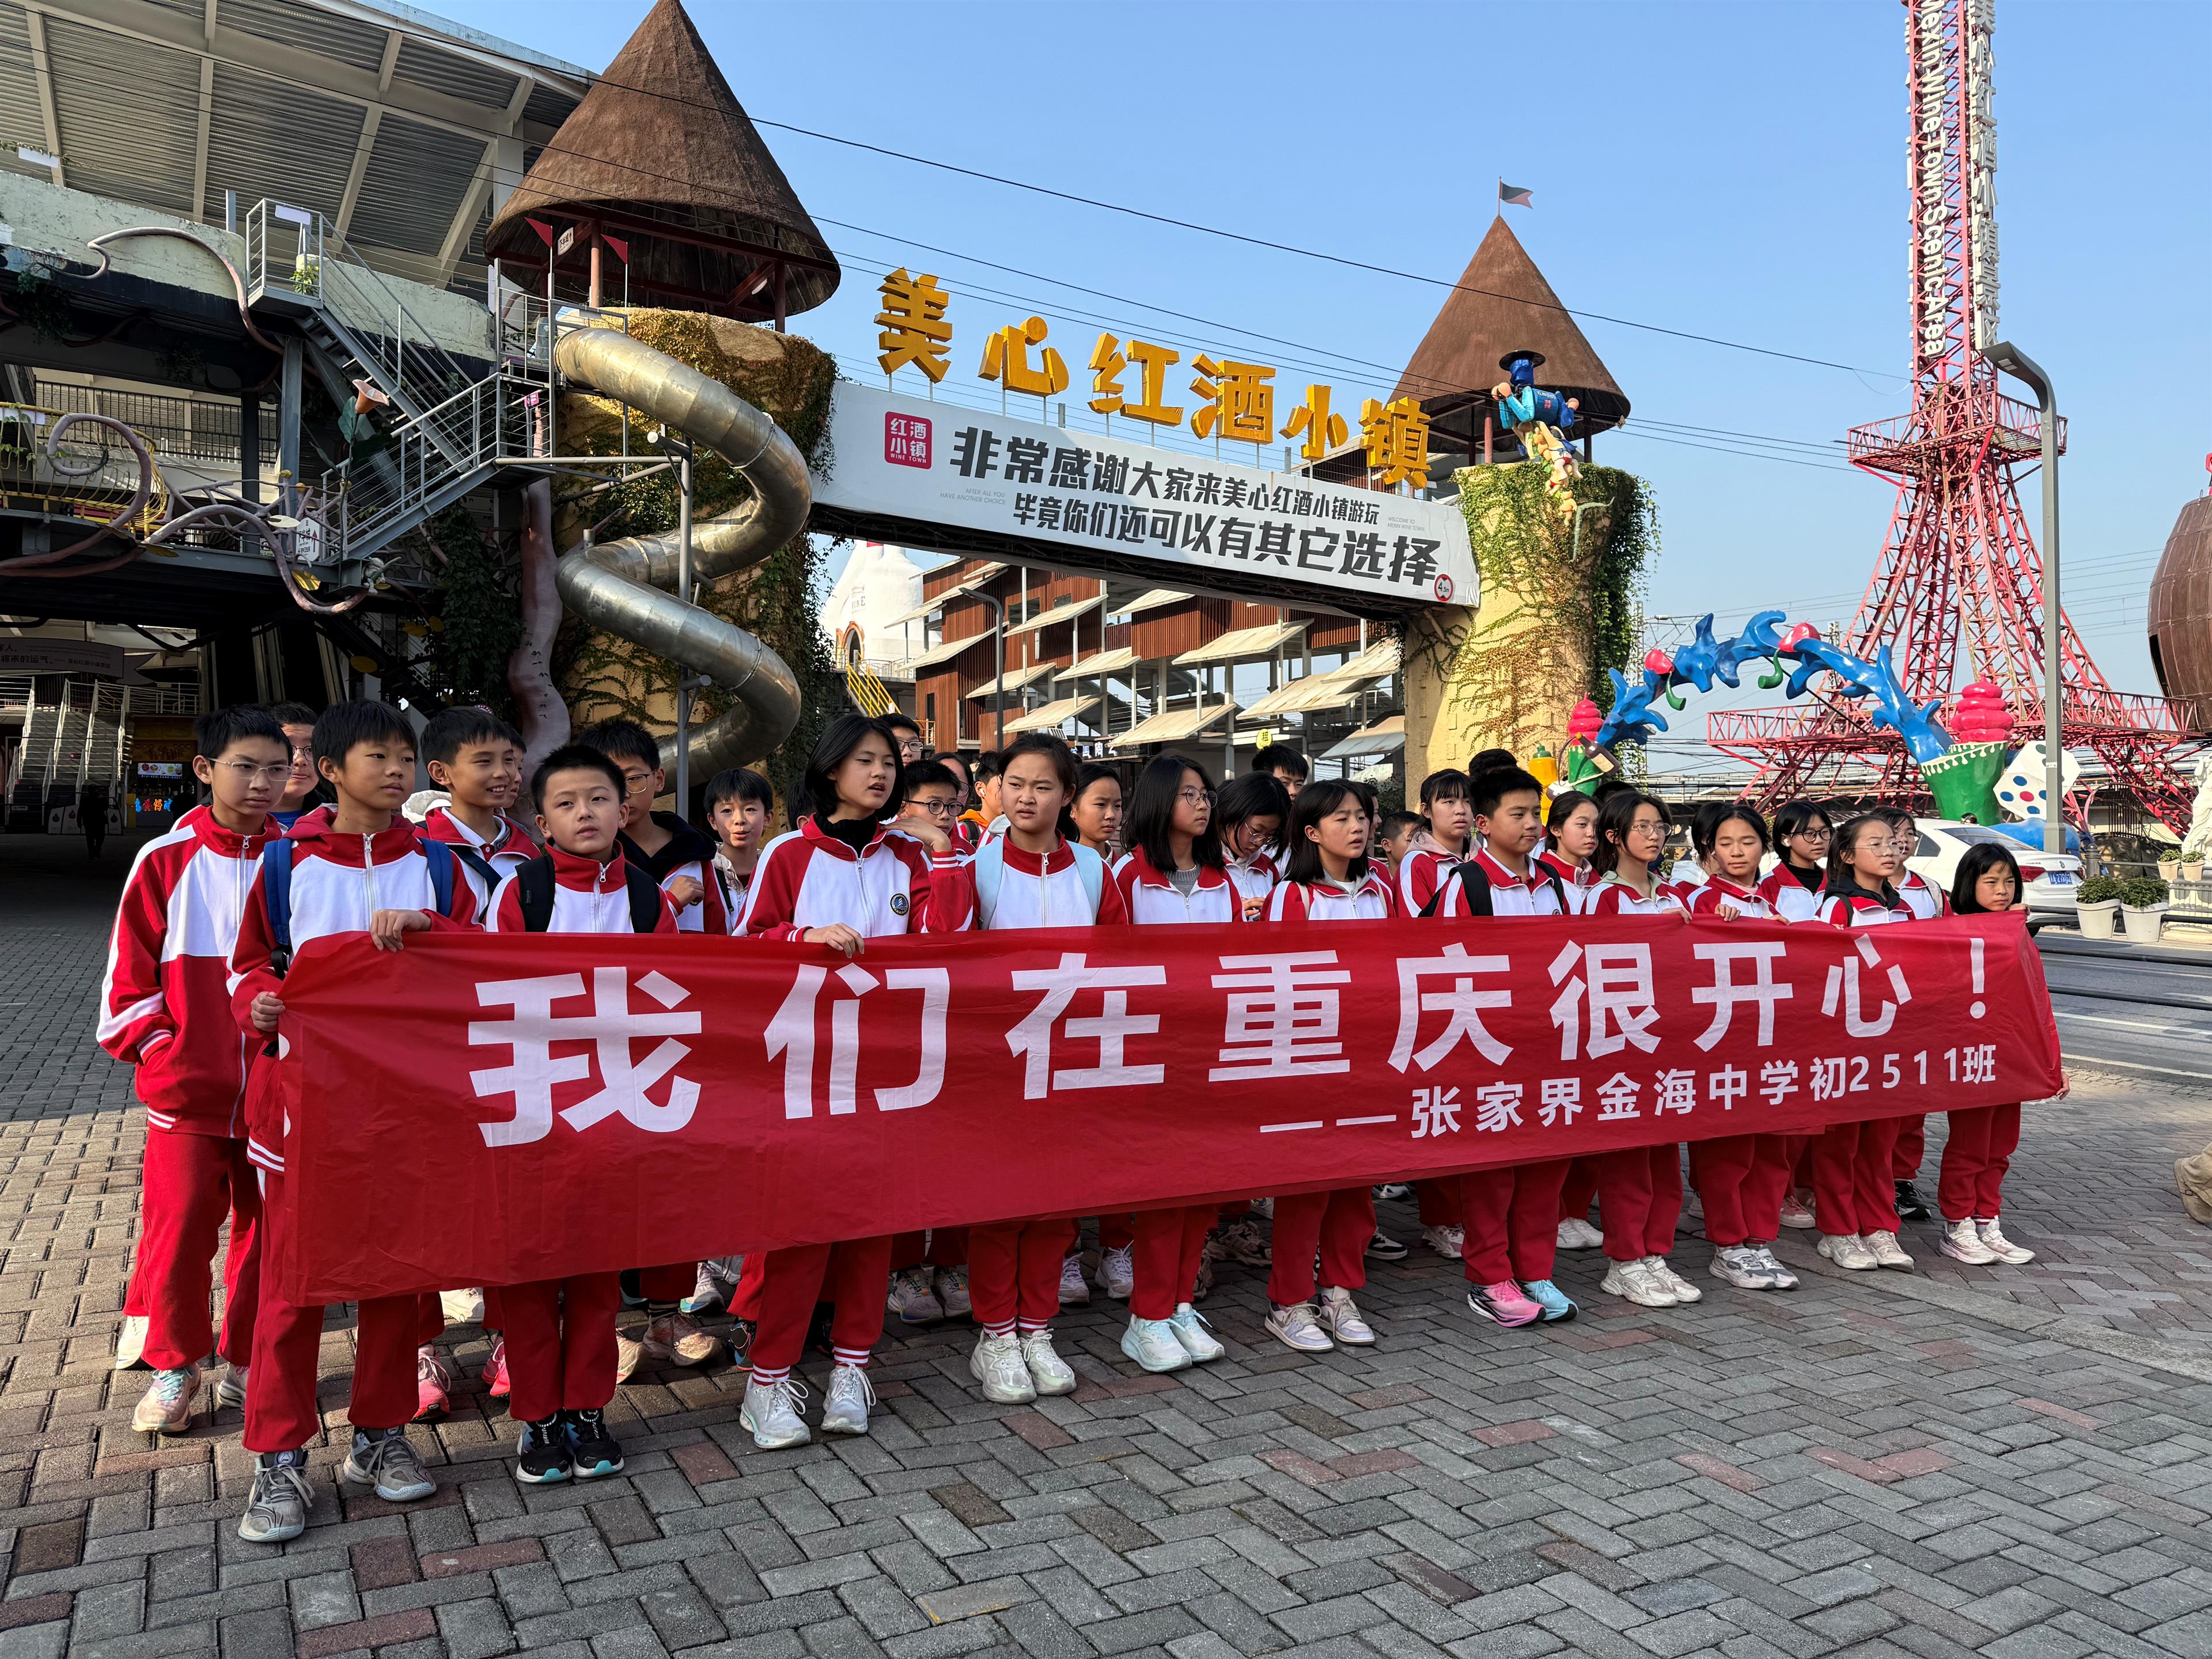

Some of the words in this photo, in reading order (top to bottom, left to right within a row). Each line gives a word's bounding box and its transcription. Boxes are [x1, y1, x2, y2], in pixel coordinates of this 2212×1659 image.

[1922, 63, 1948, 133] Wine
[1922, 131, 1948, 204] Town
[1923, 204, 1949, 293] Scenic
[1924, 295, 1950, 357] Area
[873, 267, 1432, 489] 美心红酒小镇
[890, 418, 926, 440] 红酒
[890, 438, 926, 458] 小镇
[908, 456, 926, 464] TOWN
[949, 426, 1380, 525] 非常感谢大家来美心红酒小镇游玩
[956, 494, 983, 503] ANOTHER
[984, 497, 1006, 505] CHOICE
[1013, 493, 1441, 586] 毕竟你们还可以有其它选择
[468, 938, 1986, 1147] 我们在重庆很开心！
